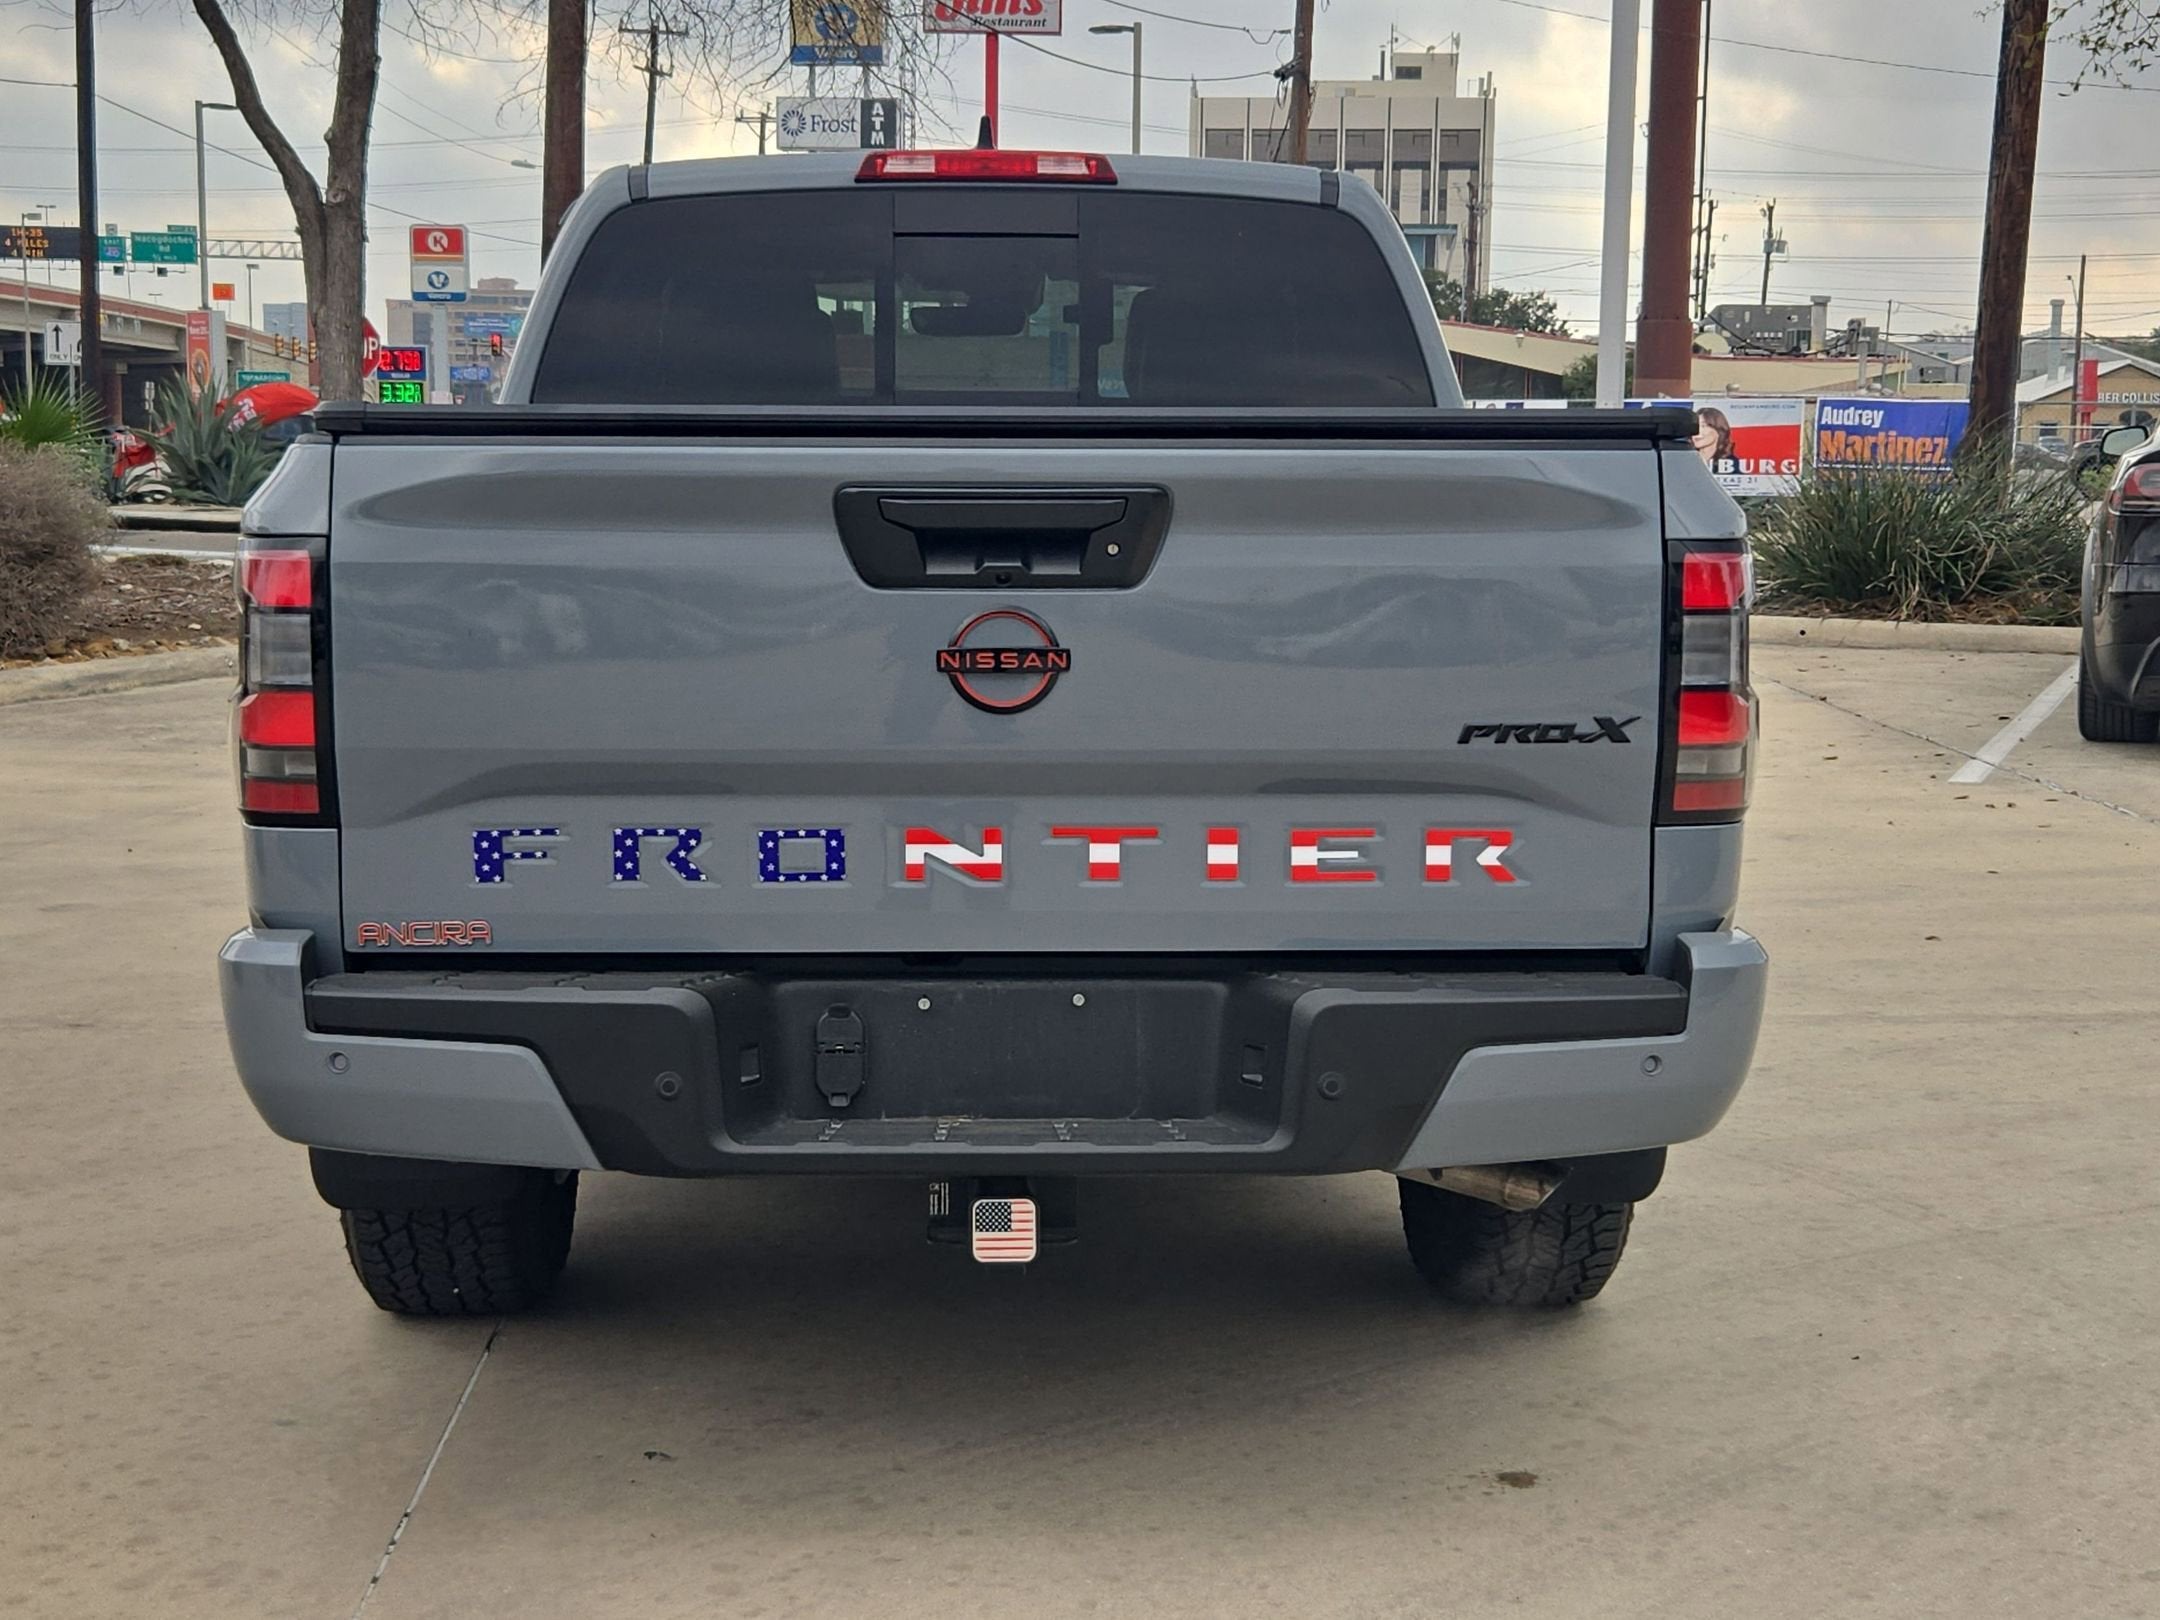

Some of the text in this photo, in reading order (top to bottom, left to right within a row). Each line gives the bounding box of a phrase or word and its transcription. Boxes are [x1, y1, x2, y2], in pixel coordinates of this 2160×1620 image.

[971, 16, 1047, 28] Restaurant
[810, 116, 857, 133] Frost
[871, 102, 885, 146] ATM
[1821, 406, 1884, 429] Audrey
[1819, 430, 1950, 465] Martinez
[939, 651, 1069, 669] NISSAN
[472, 826, 1519, 885] FRONTIER
[357, 919, 494, 947] ANCIRA
